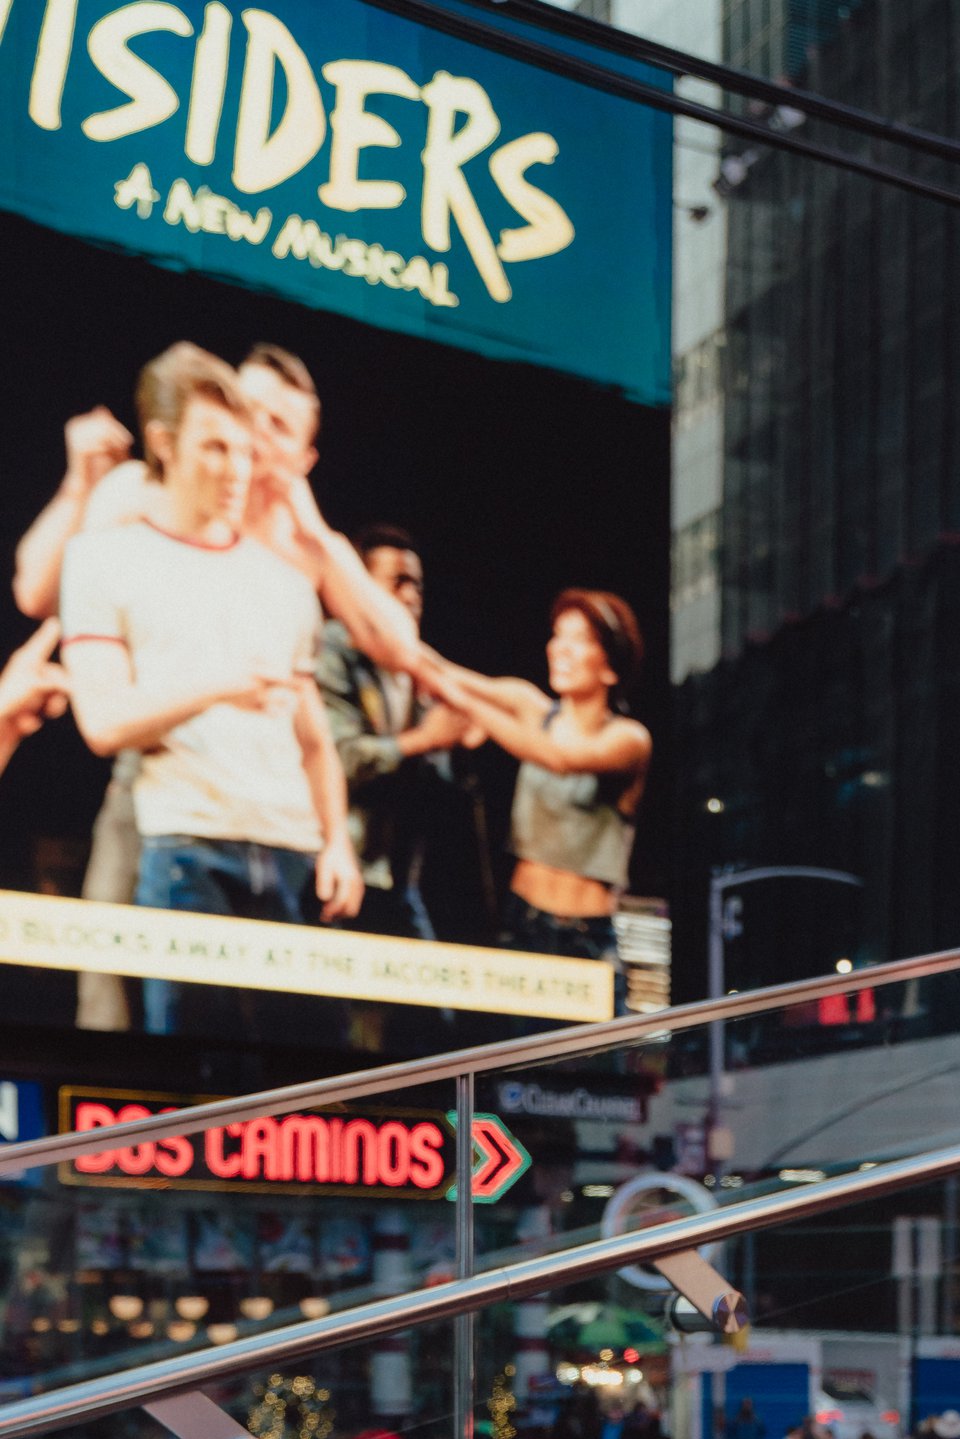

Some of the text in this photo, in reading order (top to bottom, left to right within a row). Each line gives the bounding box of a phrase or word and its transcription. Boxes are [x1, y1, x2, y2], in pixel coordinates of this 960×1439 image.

[114, 163, 459, 307] A NEW MUSICAL
